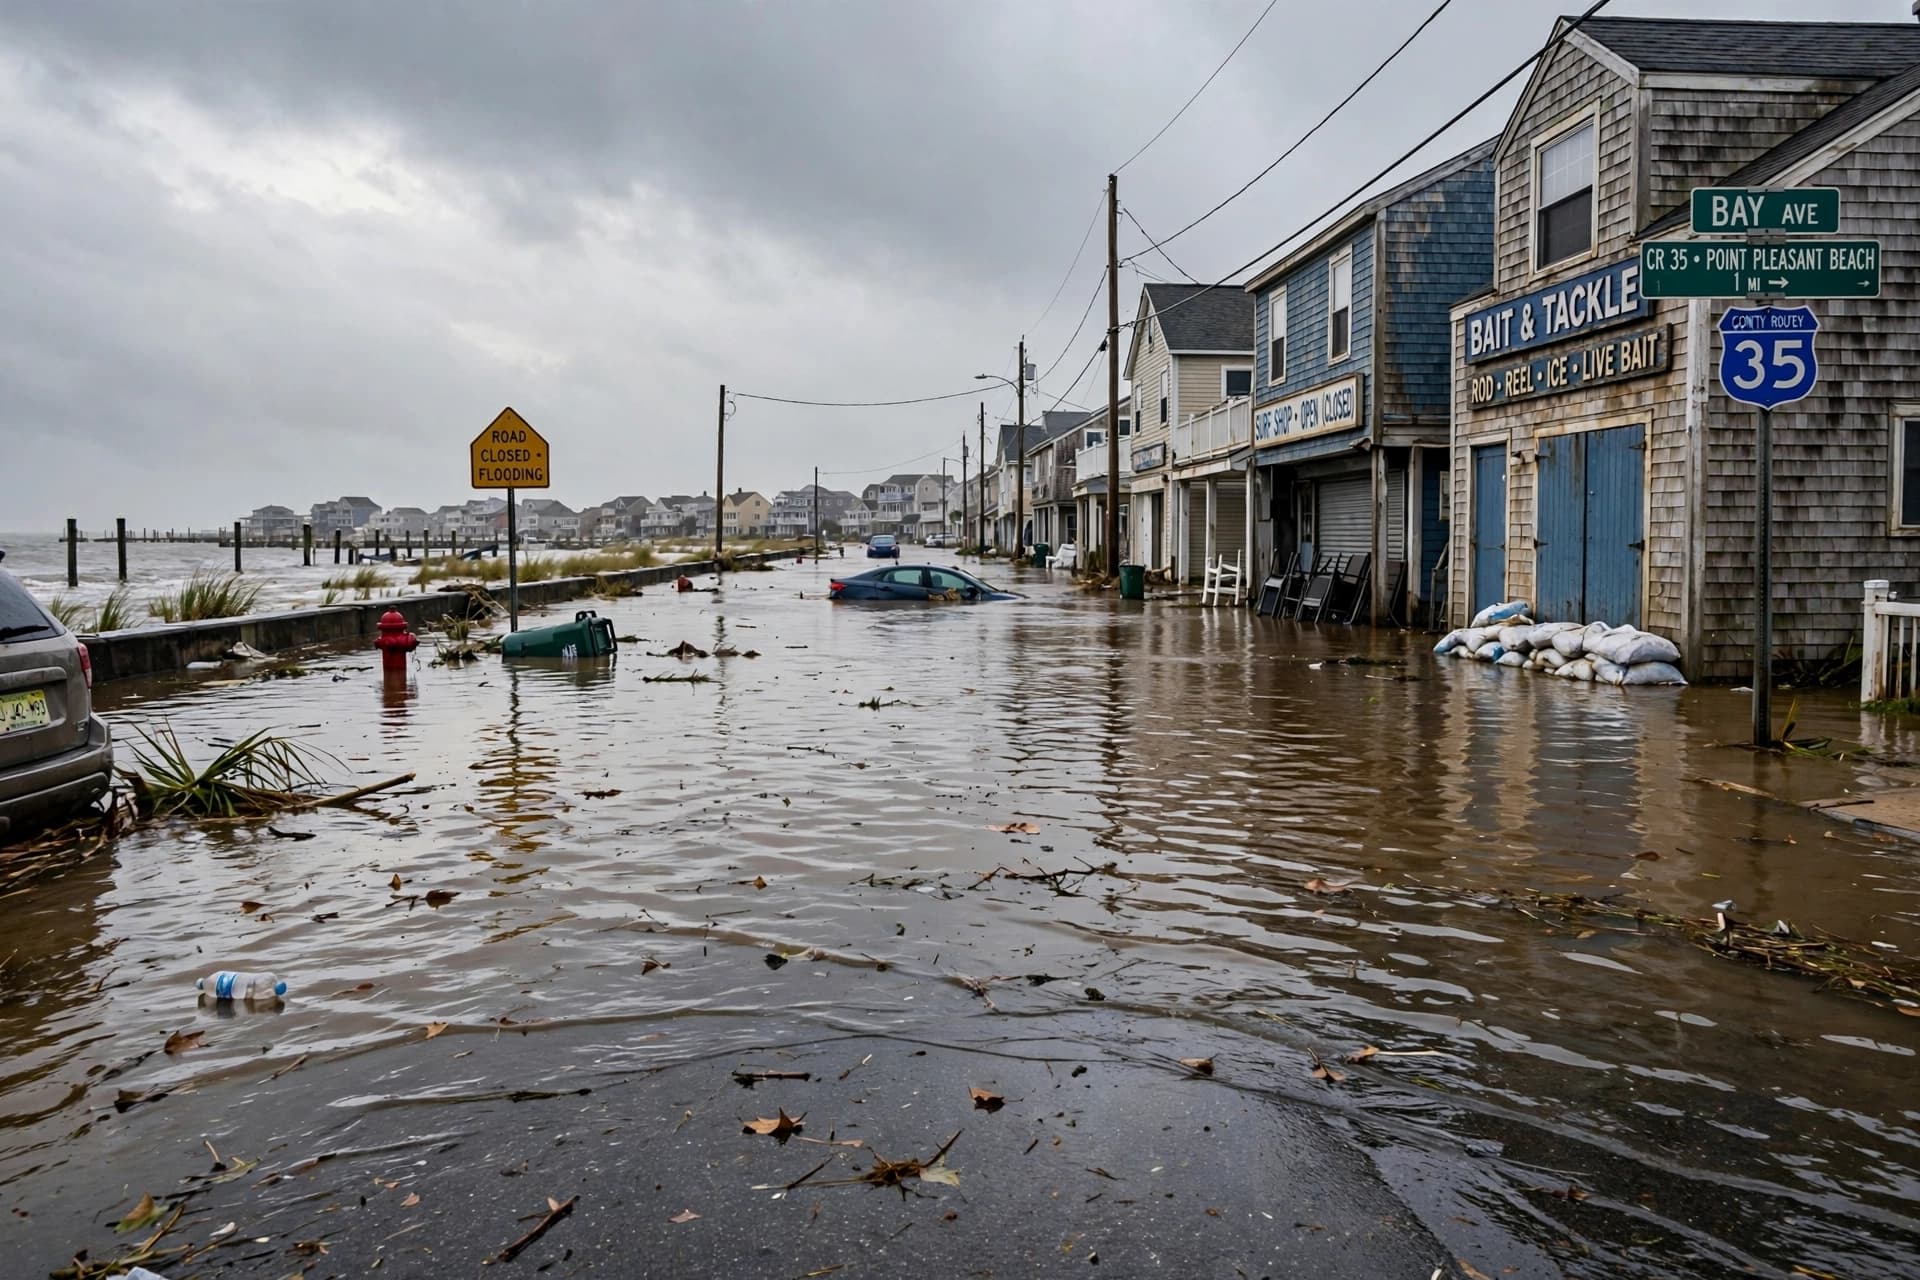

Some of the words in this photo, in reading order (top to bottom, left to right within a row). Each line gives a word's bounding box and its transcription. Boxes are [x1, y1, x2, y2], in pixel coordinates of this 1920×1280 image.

[1711, 195, 1765, 227] BAY
[1781, 203, 1819, 225] AVE
[1646, 248, 1665, 270] CR
[1670, 248, 1688, 270] 35
[1706, 248, 1747, 270] POINT
[1753, 248, 1823, 270] PLEASANT
[1829, 248, 1875, 270] BEACH
[1734, 272, 1739, 291] 1
[1748, 278, 1760, 291] MI
[1471, 308, 1514, 356] BAIT
[1520, 303, 1536, 342] &
[1542, 265, 1640, 335] TACKLE
[1471, 376, 1494, 404] ROD
[1505, 366, 1535, 397] REEL
[1546, 356, 1568, 388] ICE
[1582, 345, 1615, 381] LIVE
[1620, 333, 1658, 373] BAIT
[1732, 339, 1806, 390] 35
[1274, 405, 1292, 436] SHOP
[1301, 398, 1318, 430] OPEN
[492, 430, 526, 443] ROAD
[481, 449, 530, 462] CLOSED
[479, 467, 543, 481] FLOODING
